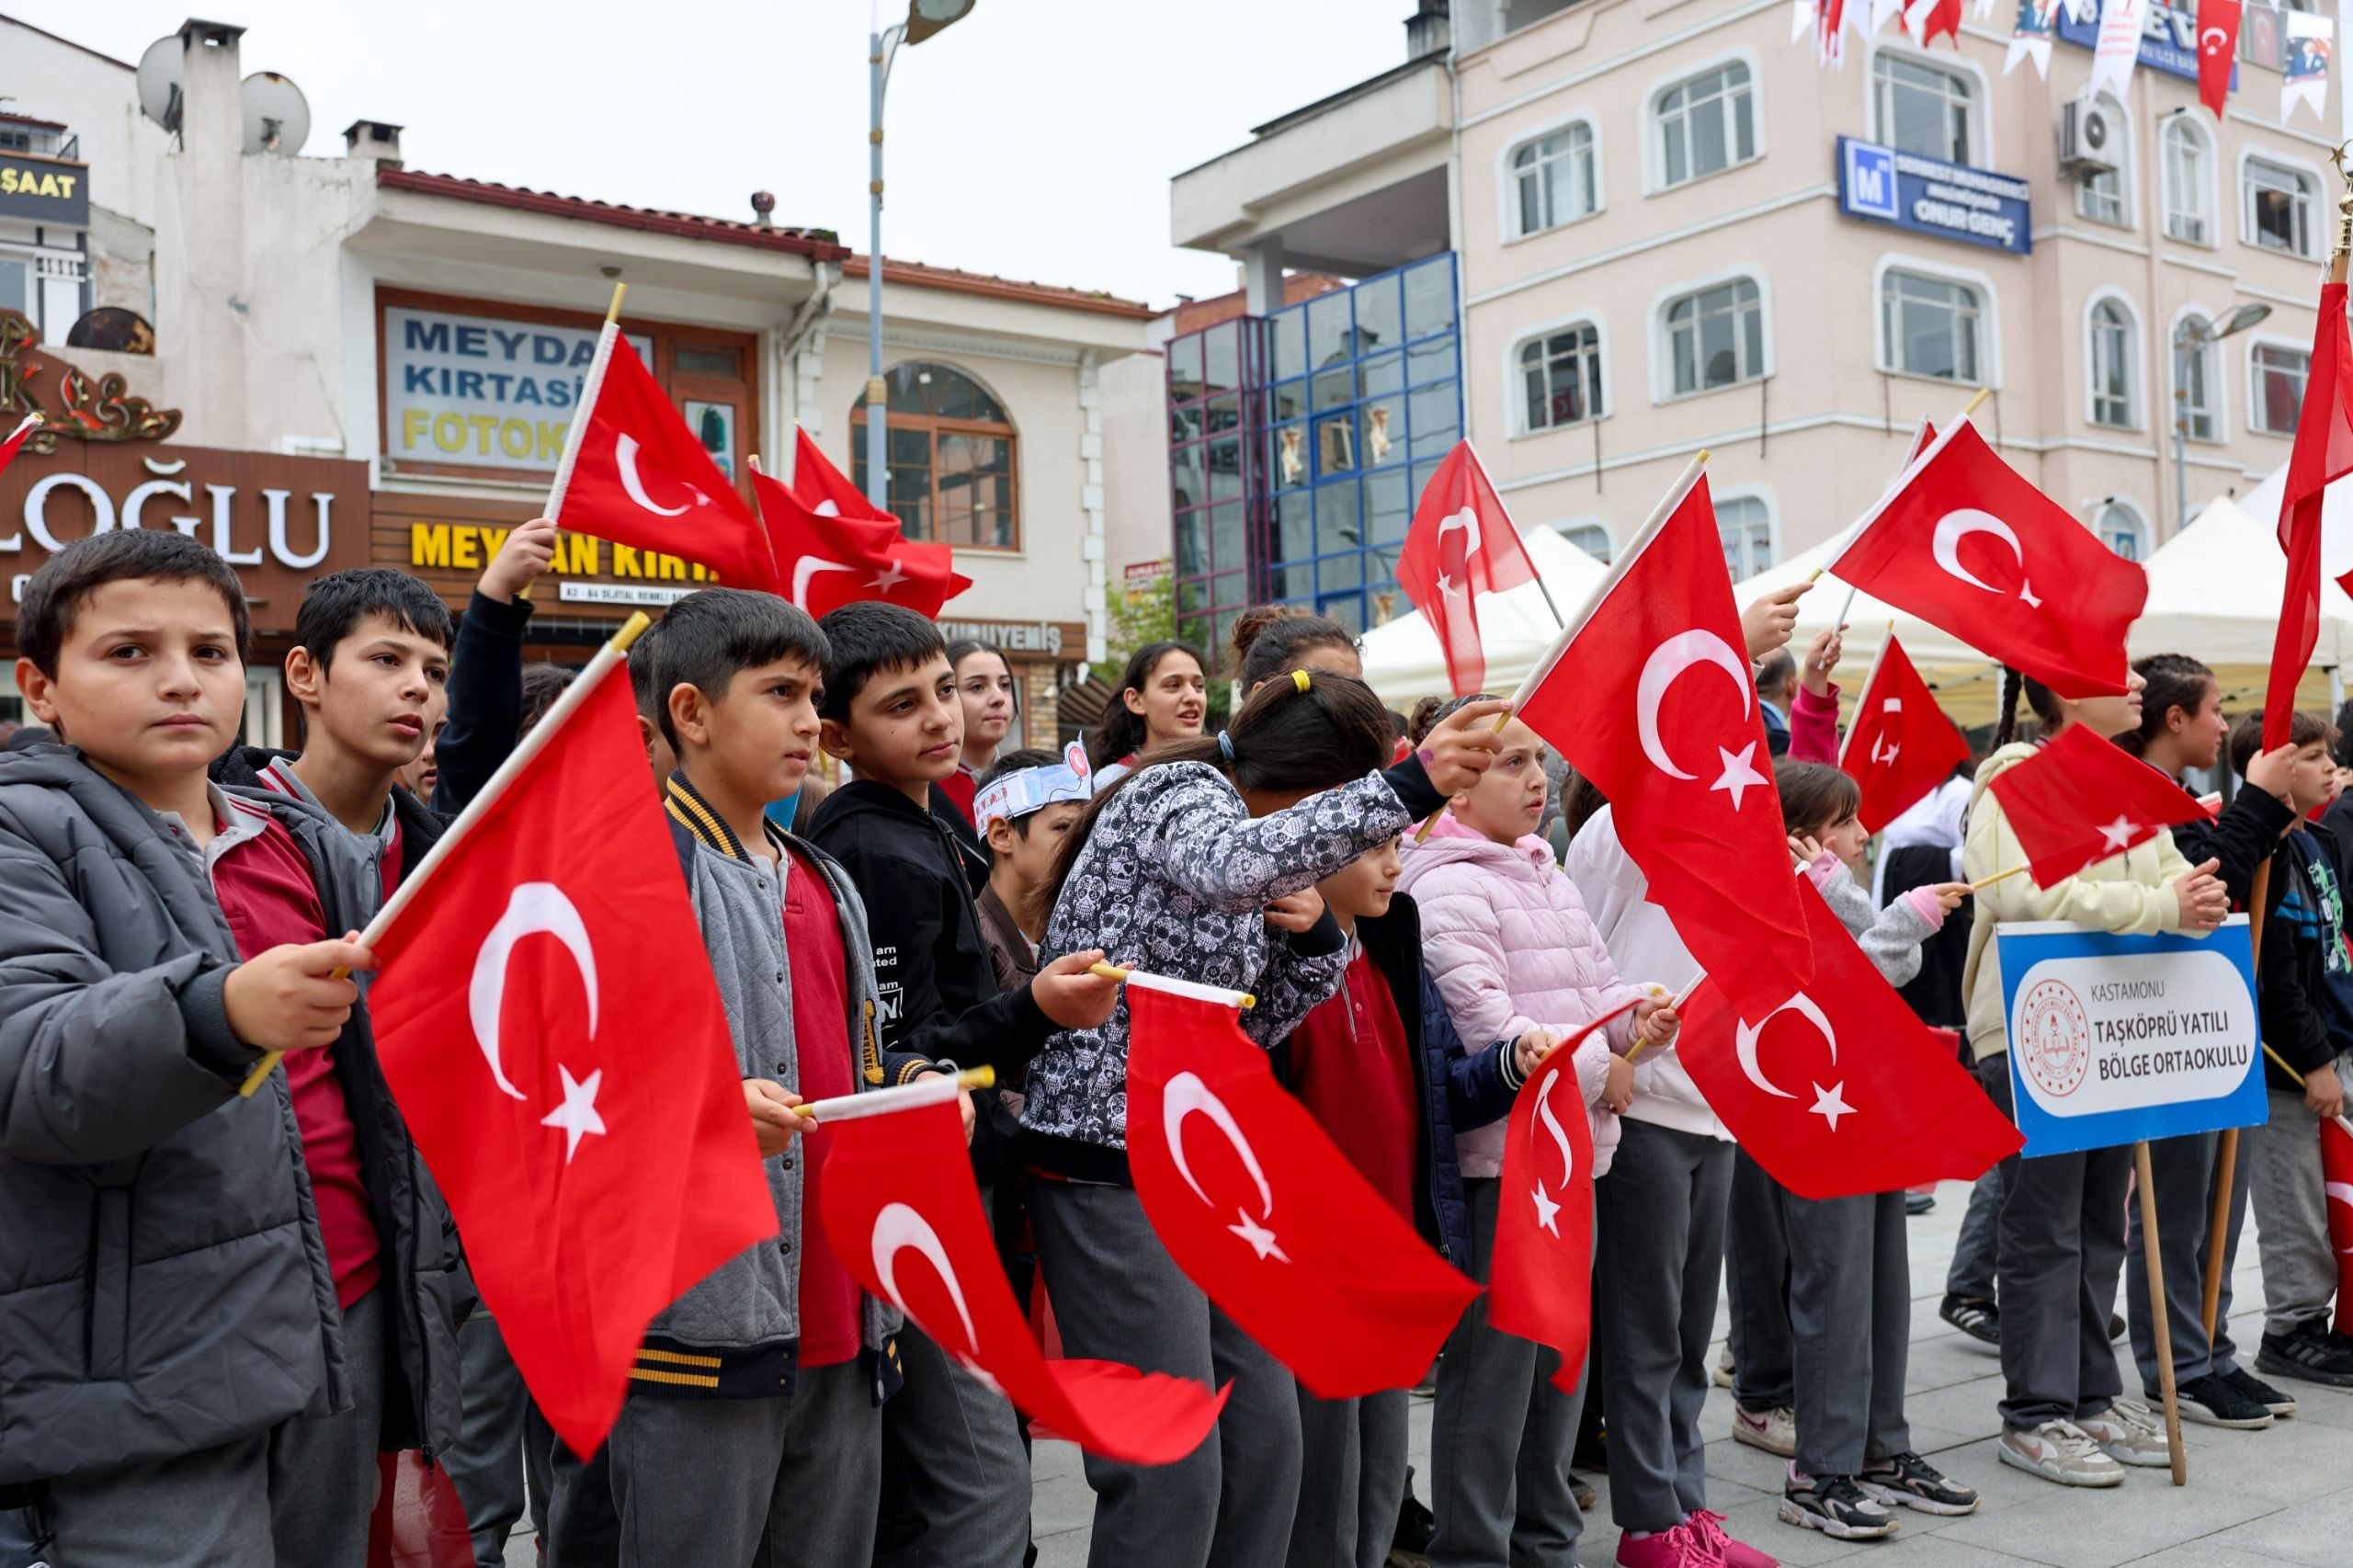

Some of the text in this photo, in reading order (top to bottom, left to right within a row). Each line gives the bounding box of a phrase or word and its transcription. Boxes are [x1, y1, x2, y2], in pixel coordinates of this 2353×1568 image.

[0, 456, 335, 568] OĞLU
[412, 523, 597, 576] MEYAN
[2091, 981, 2165, 1002] KASTAMONU
[2095, 1011, 2228, 1047] TAŞKÖPRÜ YATILI
[2099, 1044, 2247, 1081] BÖLGE ORTAOKULU
